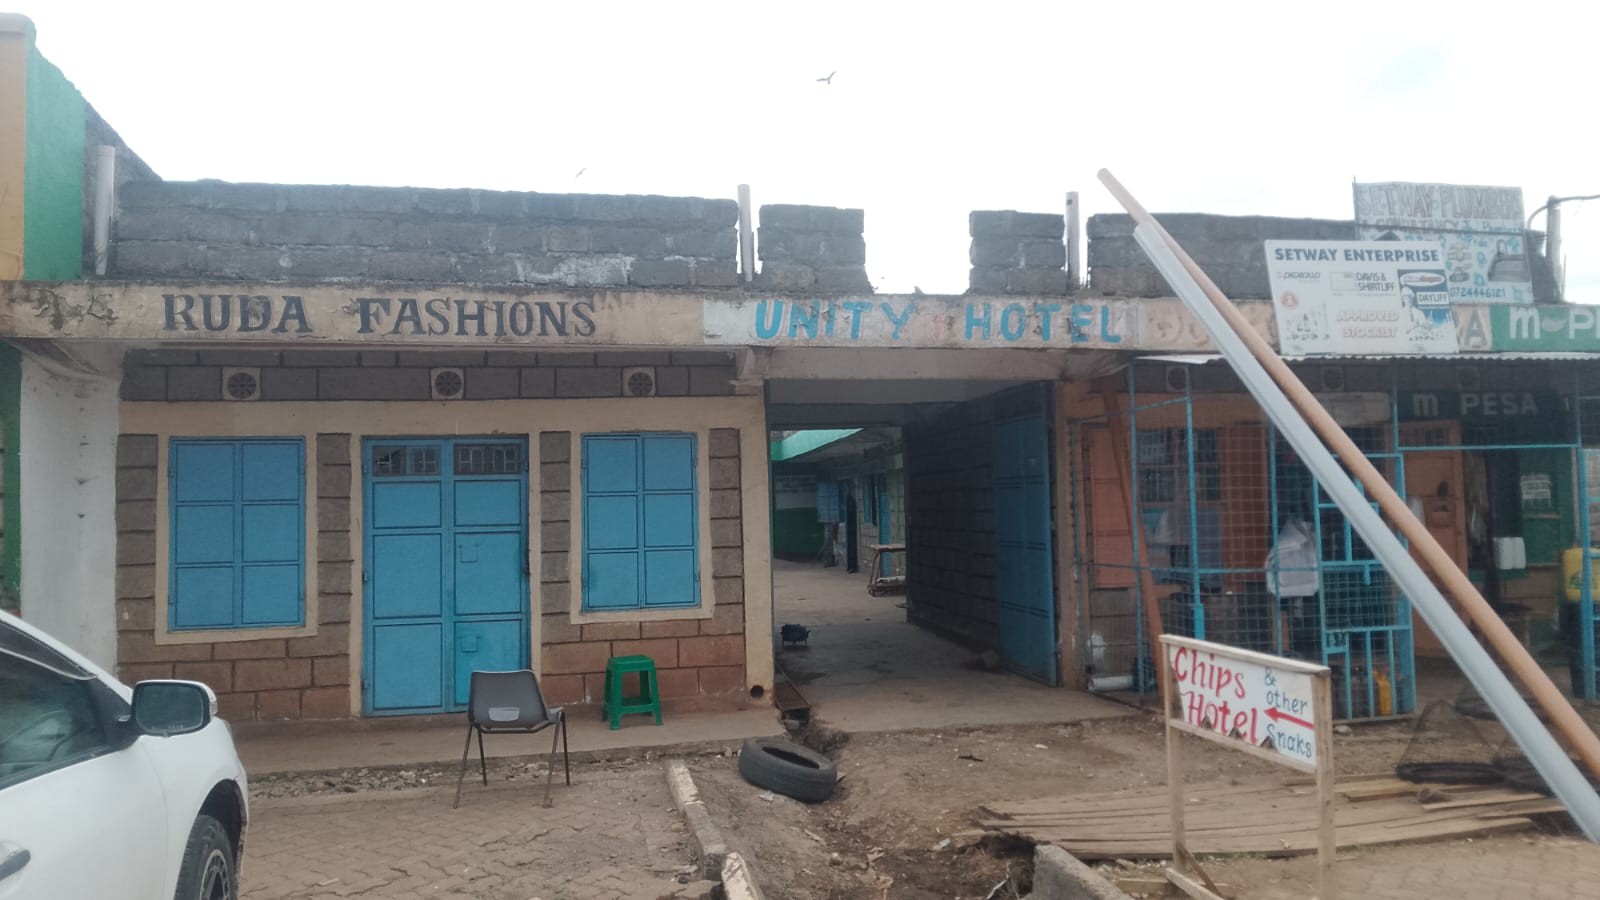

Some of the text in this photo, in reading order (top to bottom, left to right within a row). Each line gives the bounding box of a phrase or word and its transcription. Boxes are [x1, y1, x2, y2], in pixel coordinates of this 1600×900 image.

[1275, 248, 1440, 263] SETWAY ENTERPRISE
[1356, 272, 1380, 281] DAVIS
[162, 293, 597, 337] RUDA FASHIONS
[755, 299, 916, 341] UNITY
[965, 302, 1124, 344] HOTEL
[1336, 311, 1400, 322] APPROVED
[1343, 327, 1397, 338] STOCKIST
[1460, 392, 1538, 416] PESA
[1174, 646, 1246, 699] Chips
[1264, 668, 1277, 687] &
[1266, 690, 1308, 715] other
[1180, 690, 1259, 746] Hotel
[1266, 723, 1312, 758] Snaks
